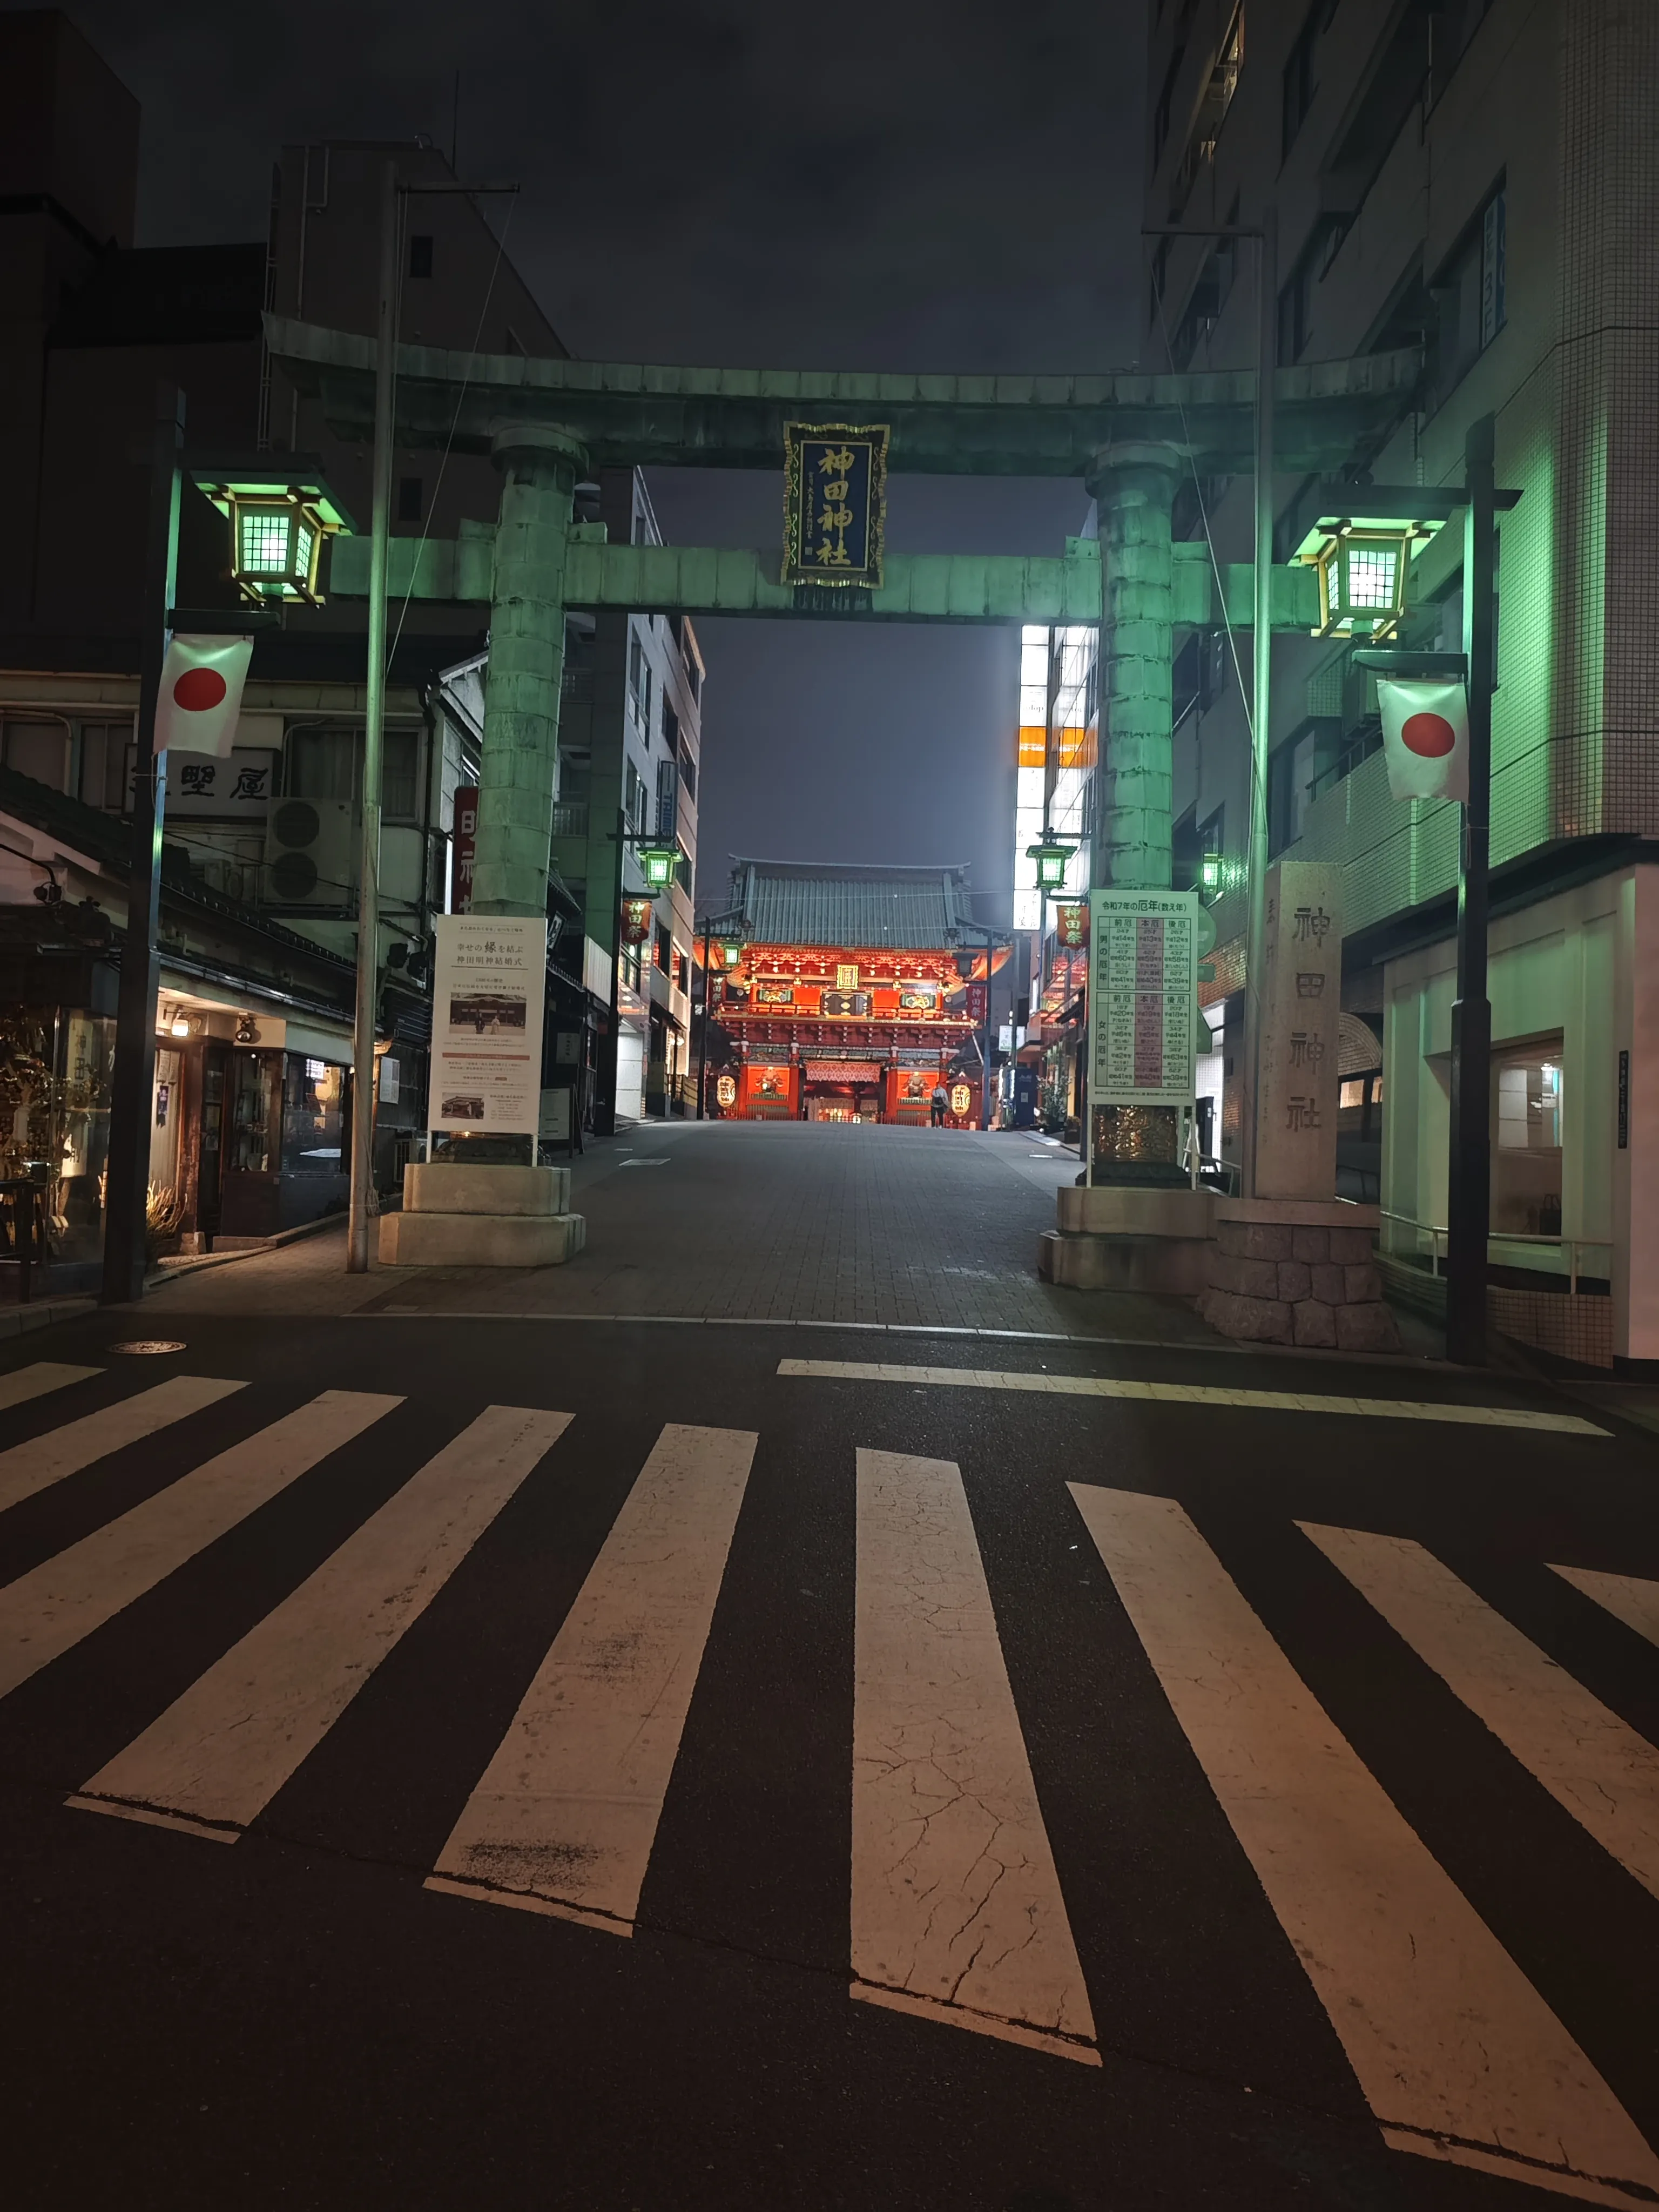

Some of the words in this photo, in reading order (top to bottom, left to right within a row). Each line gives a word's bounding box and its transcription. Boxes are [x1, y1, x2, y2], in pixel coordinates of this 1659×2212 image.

[815, 446, 855, 566] 神田神社
[626, 901, 645, 939] 神田祭
[1102, 900, 1187, 912] 令和7年の厄年(数え年)
[1063, 907, 1083, 944] 神田祭
[457, 955, 523, 966] 神田明神結婚式
[1099, 935, 1108, 981] 男の厄年
[712, 976, 724, 1003] 神田祭
[971, 988, 982, 1017] 神田祭
[1285, 906, 1330, 1132] 神田神社
[1098, 1020, 1107, 1067] 女の厄年
